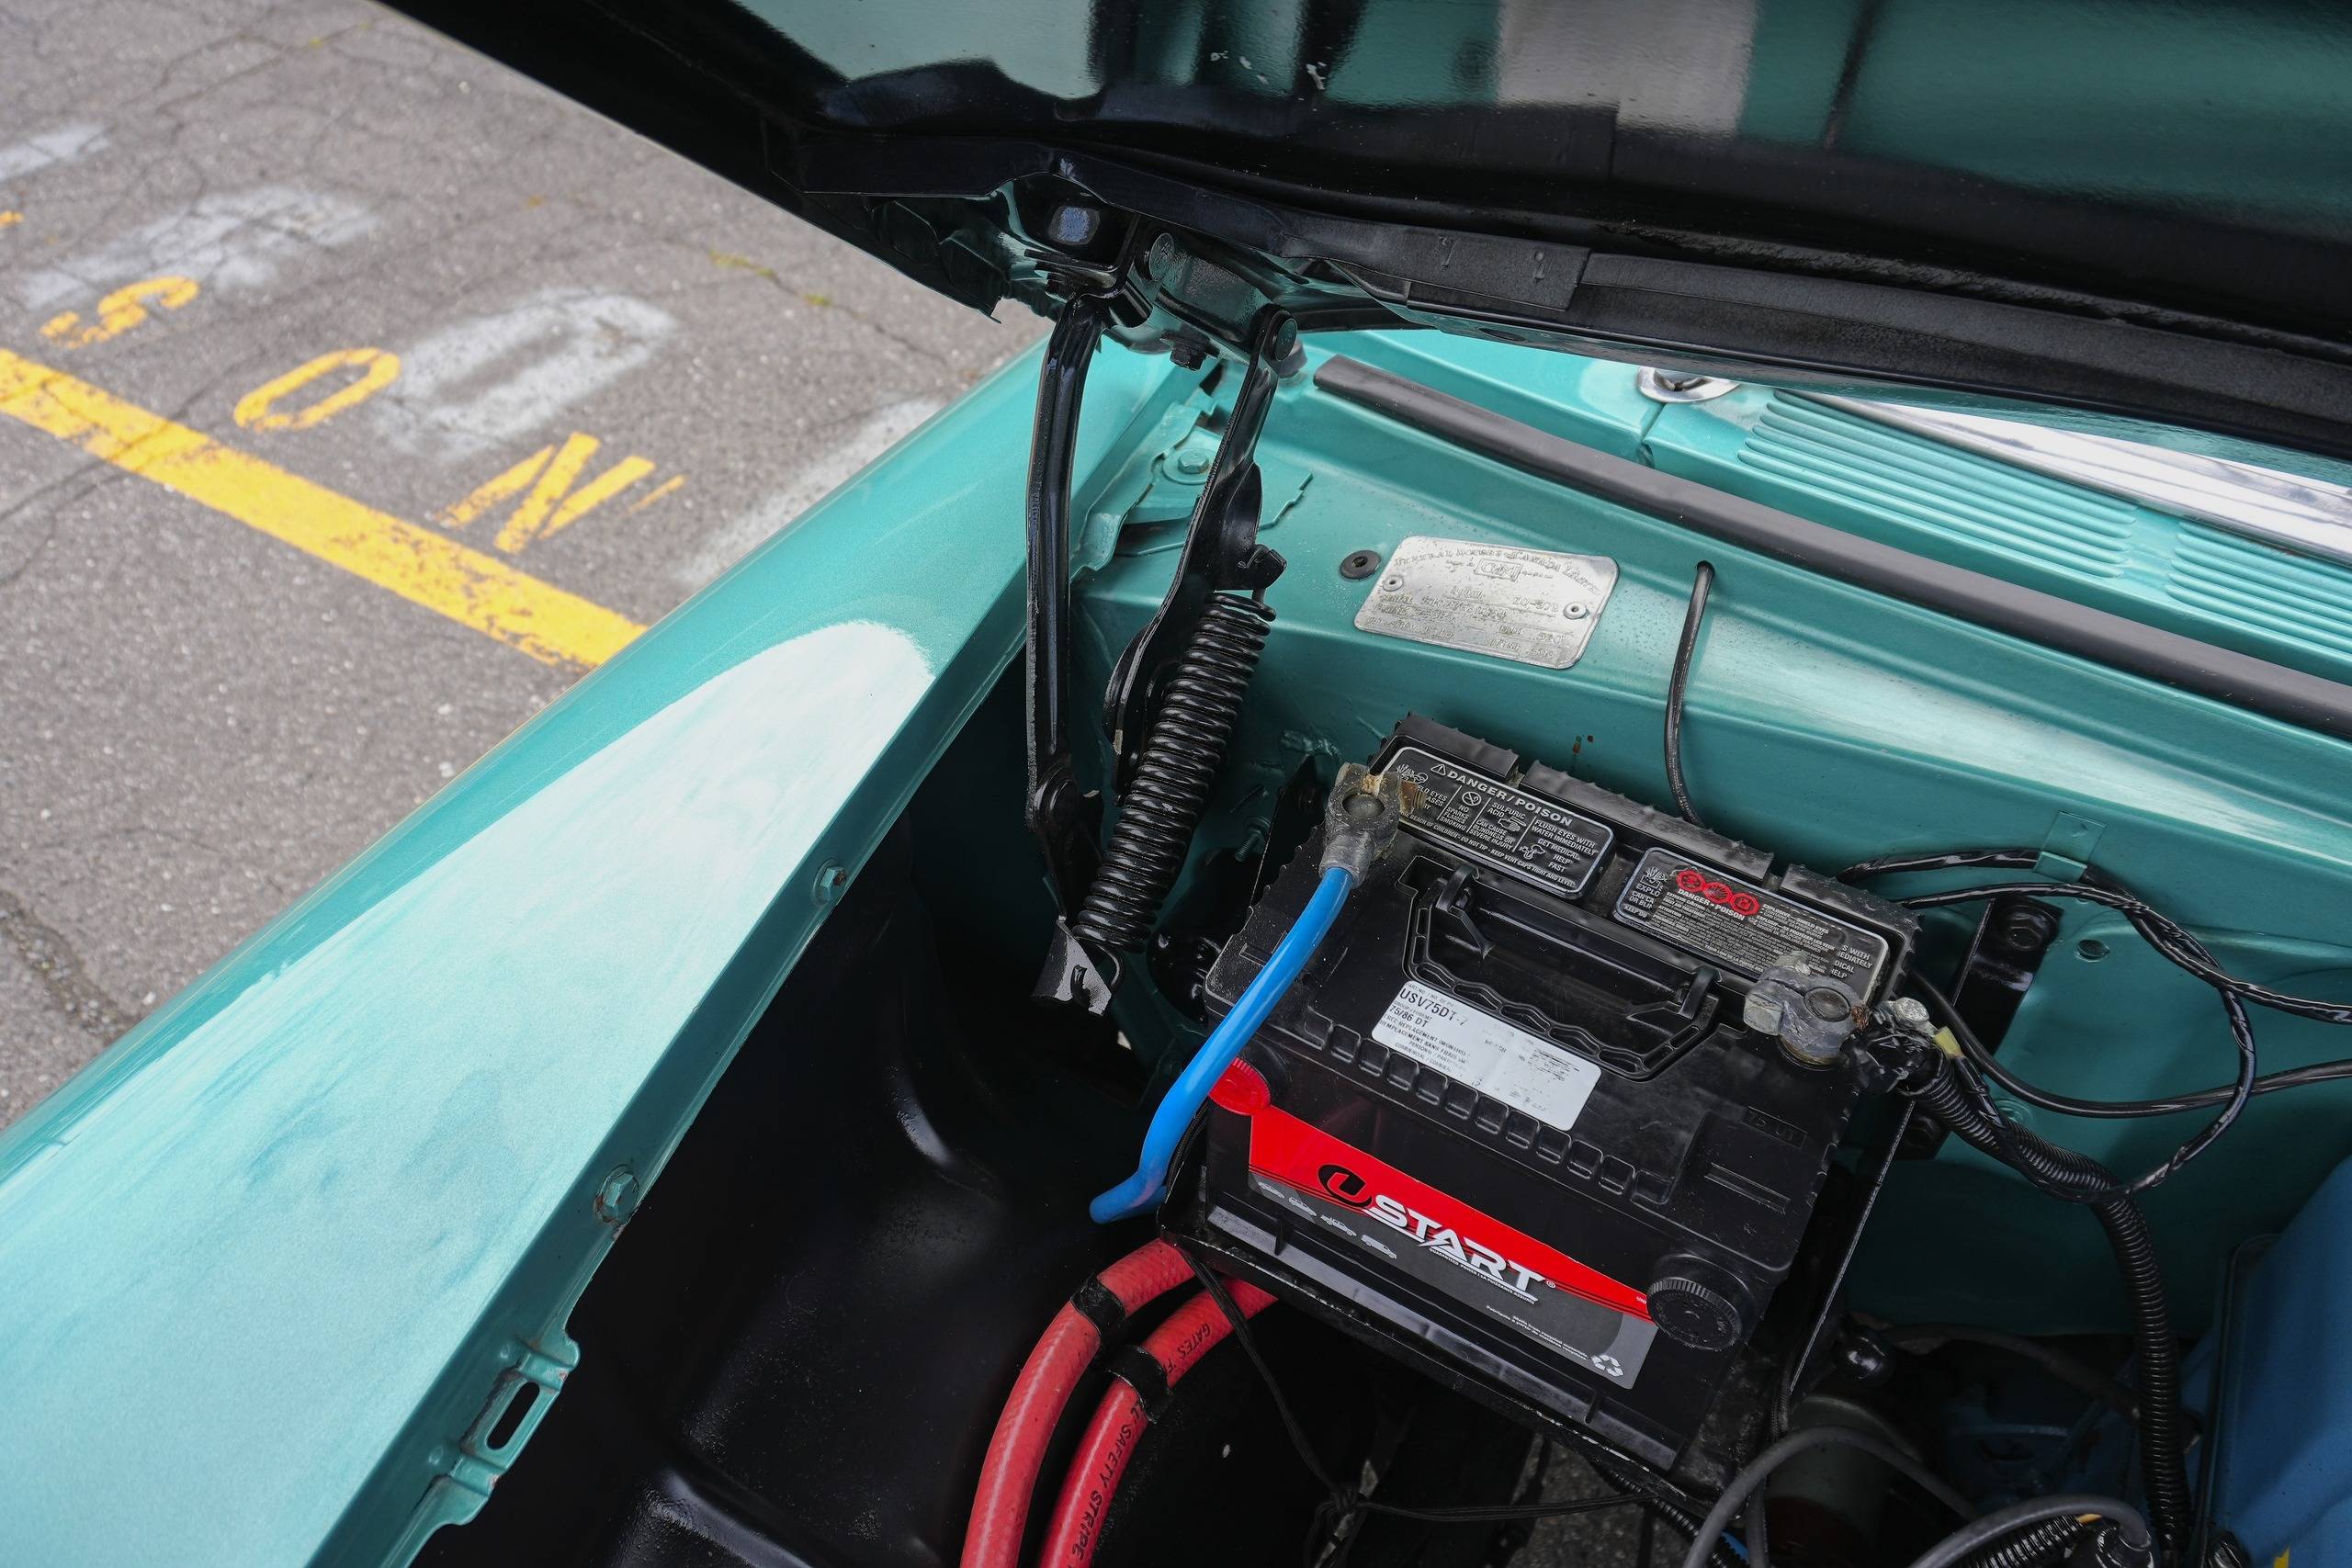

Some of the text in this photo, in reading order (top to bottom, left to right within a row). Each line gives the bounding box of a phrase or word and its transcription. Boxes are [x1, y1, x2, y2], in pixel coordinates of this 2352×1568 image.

[1425, 795, 1444, 807] ASES
[1429, 789, 1448, 802] EYES
[1445, 806, 1470, 820] SPARKS
[1457, 804, 1470, 813] NO
[1487, 806, 1505, 818] ACID
[1490, 801, 1526, 819] SULFURIC
[1438, 815, 1467, 831] SMOKING
[1442, 810, 1466, 824] FLAMES
[1472, 823, 1513, 844] BLINDNESS OR
[1475, 818, 1508, 836] CAN CAUSE
[1533, 818, 1596, 849] FLUSH EYES WITH
[1468, 828, 1513, 851] SEVERE INJURY
[1530, 825, 1597, 856] WATER IMMEDIATELY
[1432, 823, 1458, 838] CHILDREN
[1467, 839, 1479, 848] NOT
[1478, 842, 1488, 852] TIP
[1489, 848, 1505, 858] KEEP
[1503, 853, 1518, 864] VENT
[1516, 859, 1532, 870] CAPS
[1531, 865, 1547, 876] TIGHT
[1545, 871, 1559, 881] AND
[1536, 837, 1581, 861] GET MEDICAL
[1552, 852, 1571, 865] HELP
[1547, 861, 1566, 873] FAST
[1631, 889, 1645, 900] CAN
[1634, 882, 1661, 897] EXPLO
[1628, 895, 1639, 904] OR
[1677, 888, 1711, 906] DANGER
[1713, 903, 1746, 921] POISON
[1623, 903, 1639, 914] KEEP
[1837, 950, 1873, 969] EDIATELY
[1848, 946, 1871, 961] WITH
[1833, 959, 1857, 974] DICAL
[1387, 1004, 1429, 1028] 75/86 DT
[1423, 1040, 1440, 1051] SANS
[1374, 1194, 1546, 1293] START
[1071, 1323, 1211, 1562] GATES SAFETY STRIPE
